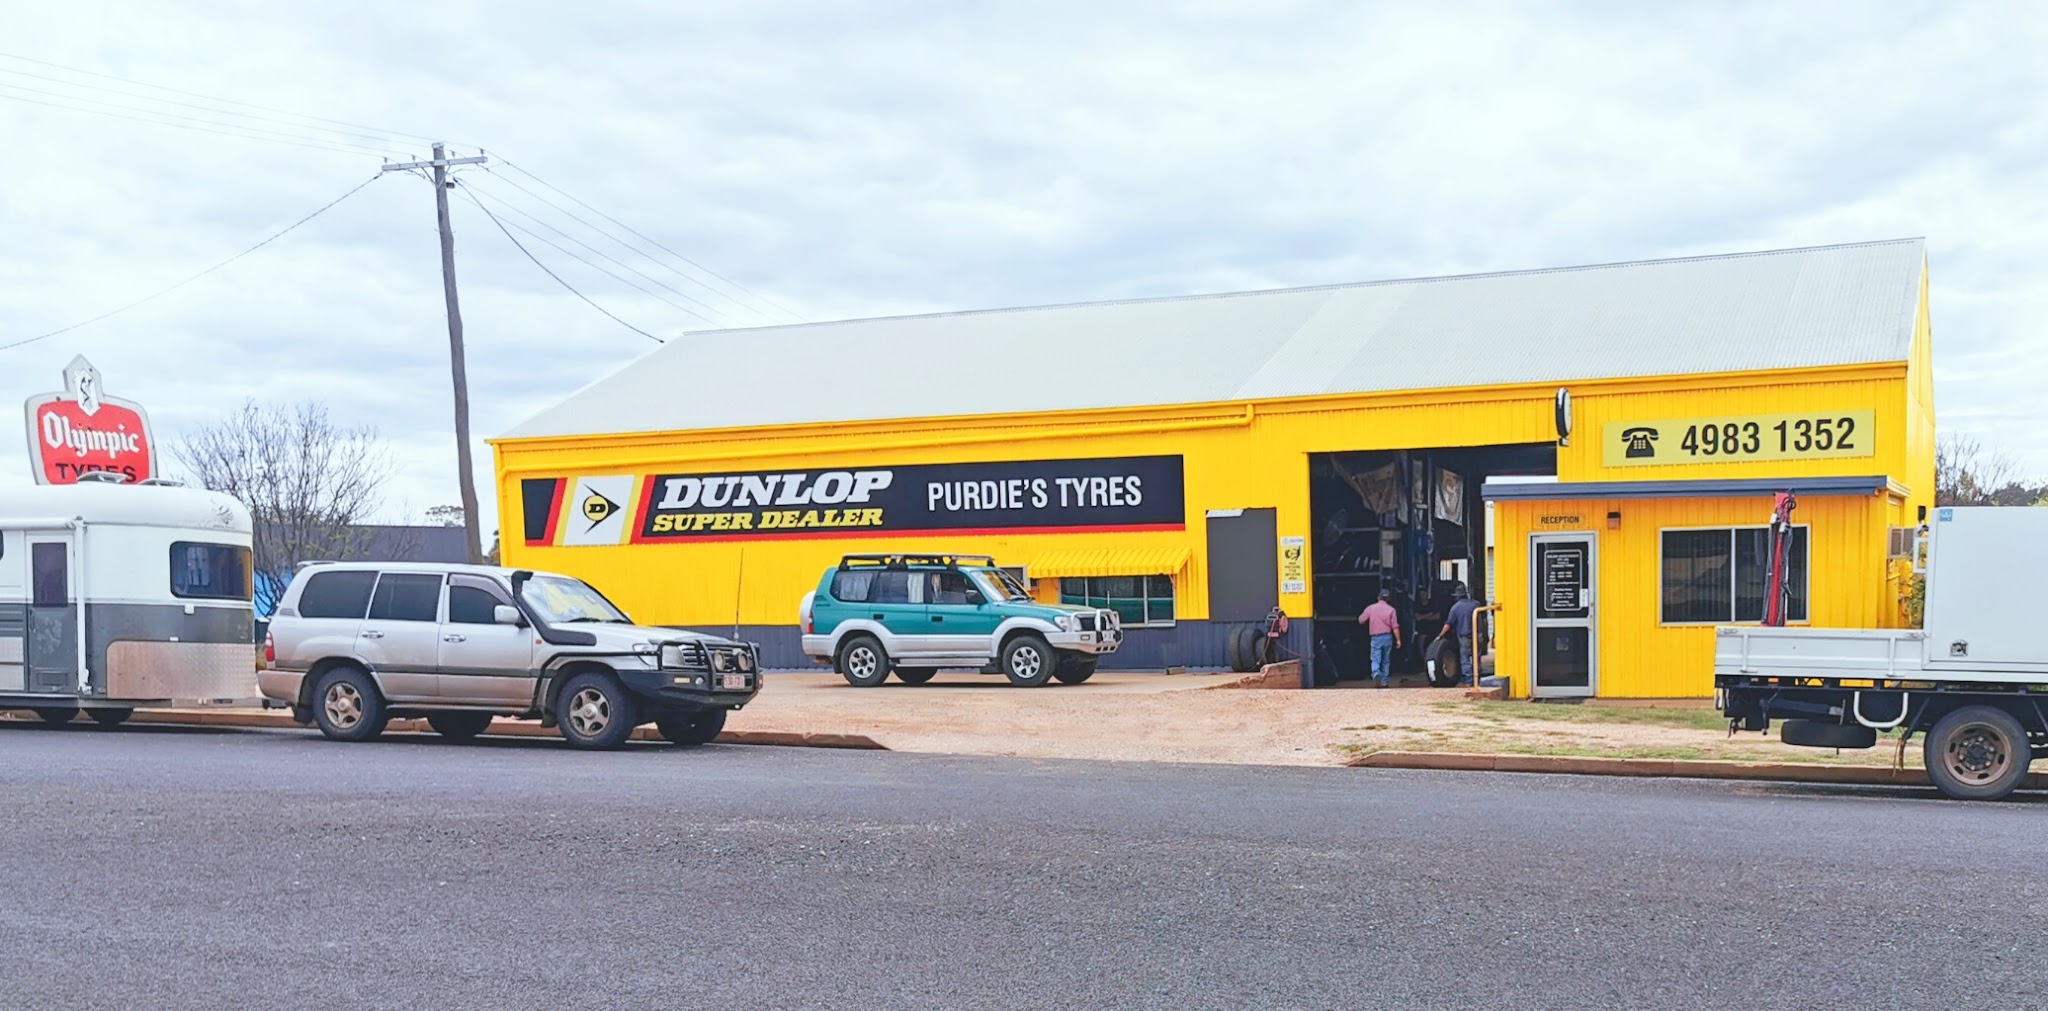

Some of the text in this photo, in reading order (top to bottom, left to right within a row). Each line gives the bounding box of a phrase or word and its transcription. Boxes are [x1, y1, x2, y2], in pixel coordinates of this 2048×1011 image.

[43, 411, 140, 459] Olympic
[1681, 417, 1855, 456] 4983 1352
[657, 470, 893, 510] DUNLOP
[927, 475, 1142, 511] PURDIE'S TYRES
[652, 508, 883, 532] SUPER DEALER
[1540, 516, 1580, 524] RECEPTION
